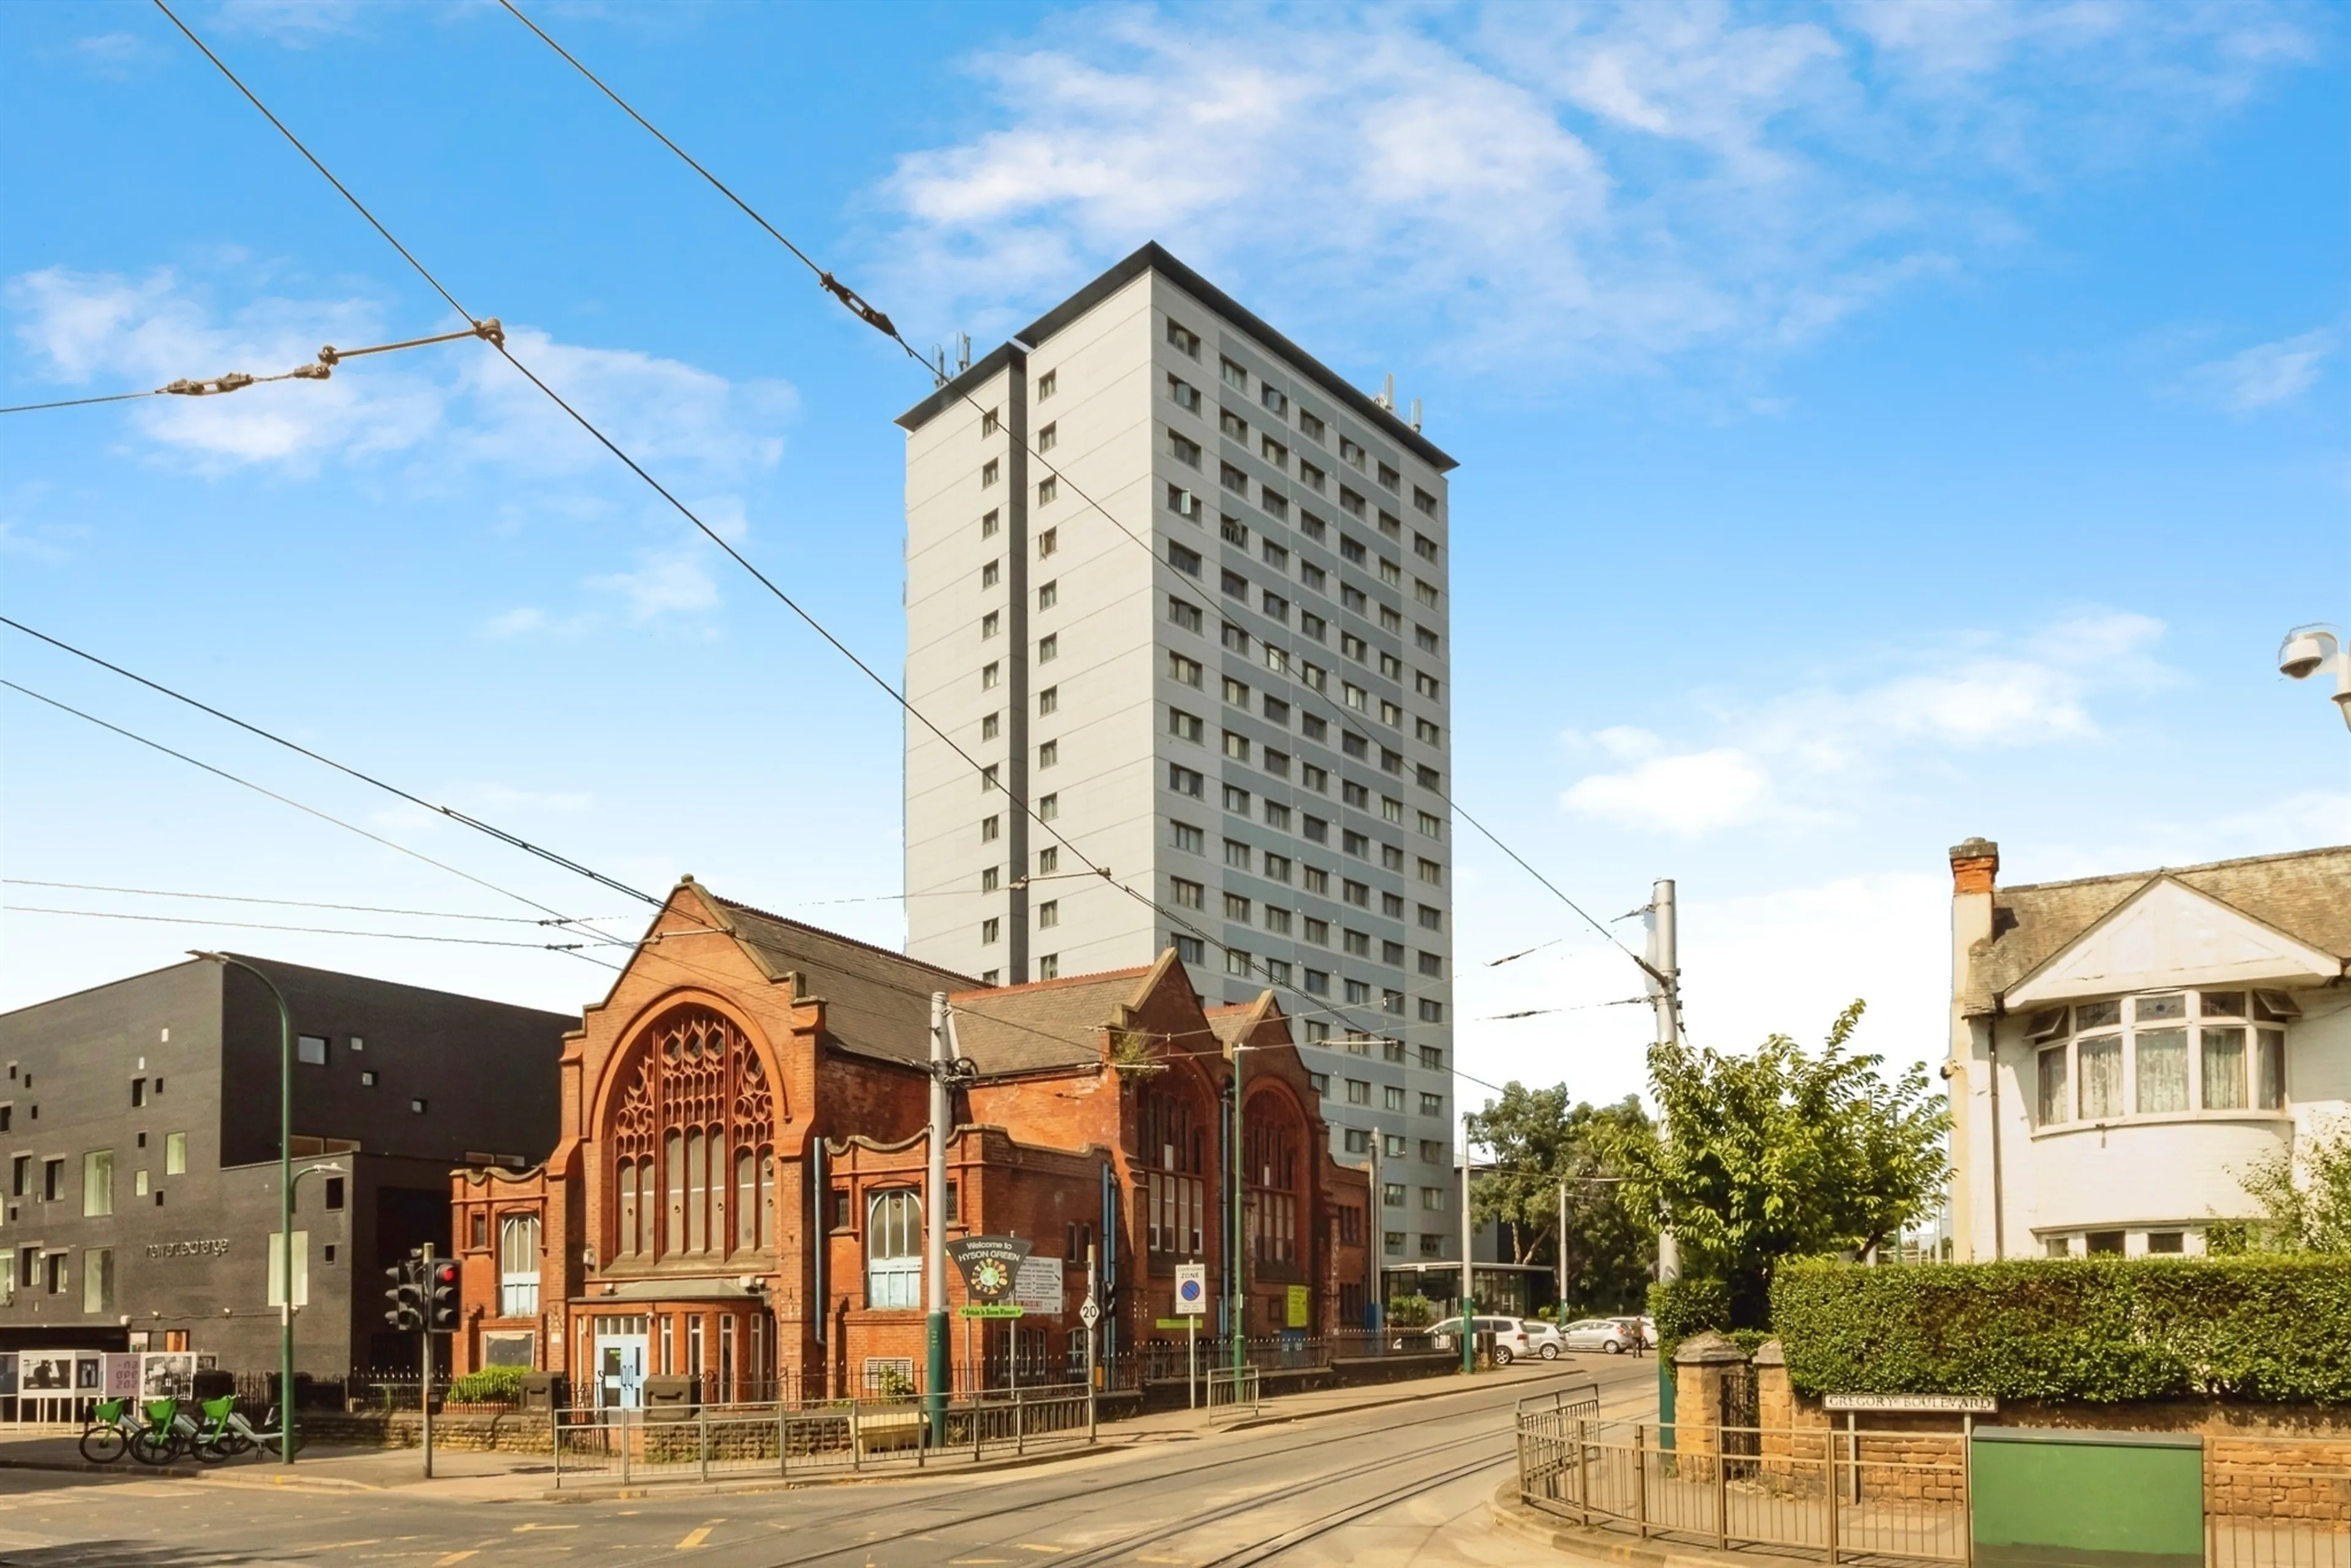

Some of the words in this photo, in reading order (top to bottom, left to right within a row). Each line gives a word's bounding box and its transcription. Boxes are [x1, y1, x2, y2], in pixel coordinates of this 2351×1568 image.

[958, 1250, 989, 1261] HYSON
[990, 1250, 1020, 1261] GREEN
[1083, 1305, 1097, 1318] 20
[1829, 1396, 1894, 1407] GREGORY
[1904, 1397, 1990, 1409] BOULEVARD
